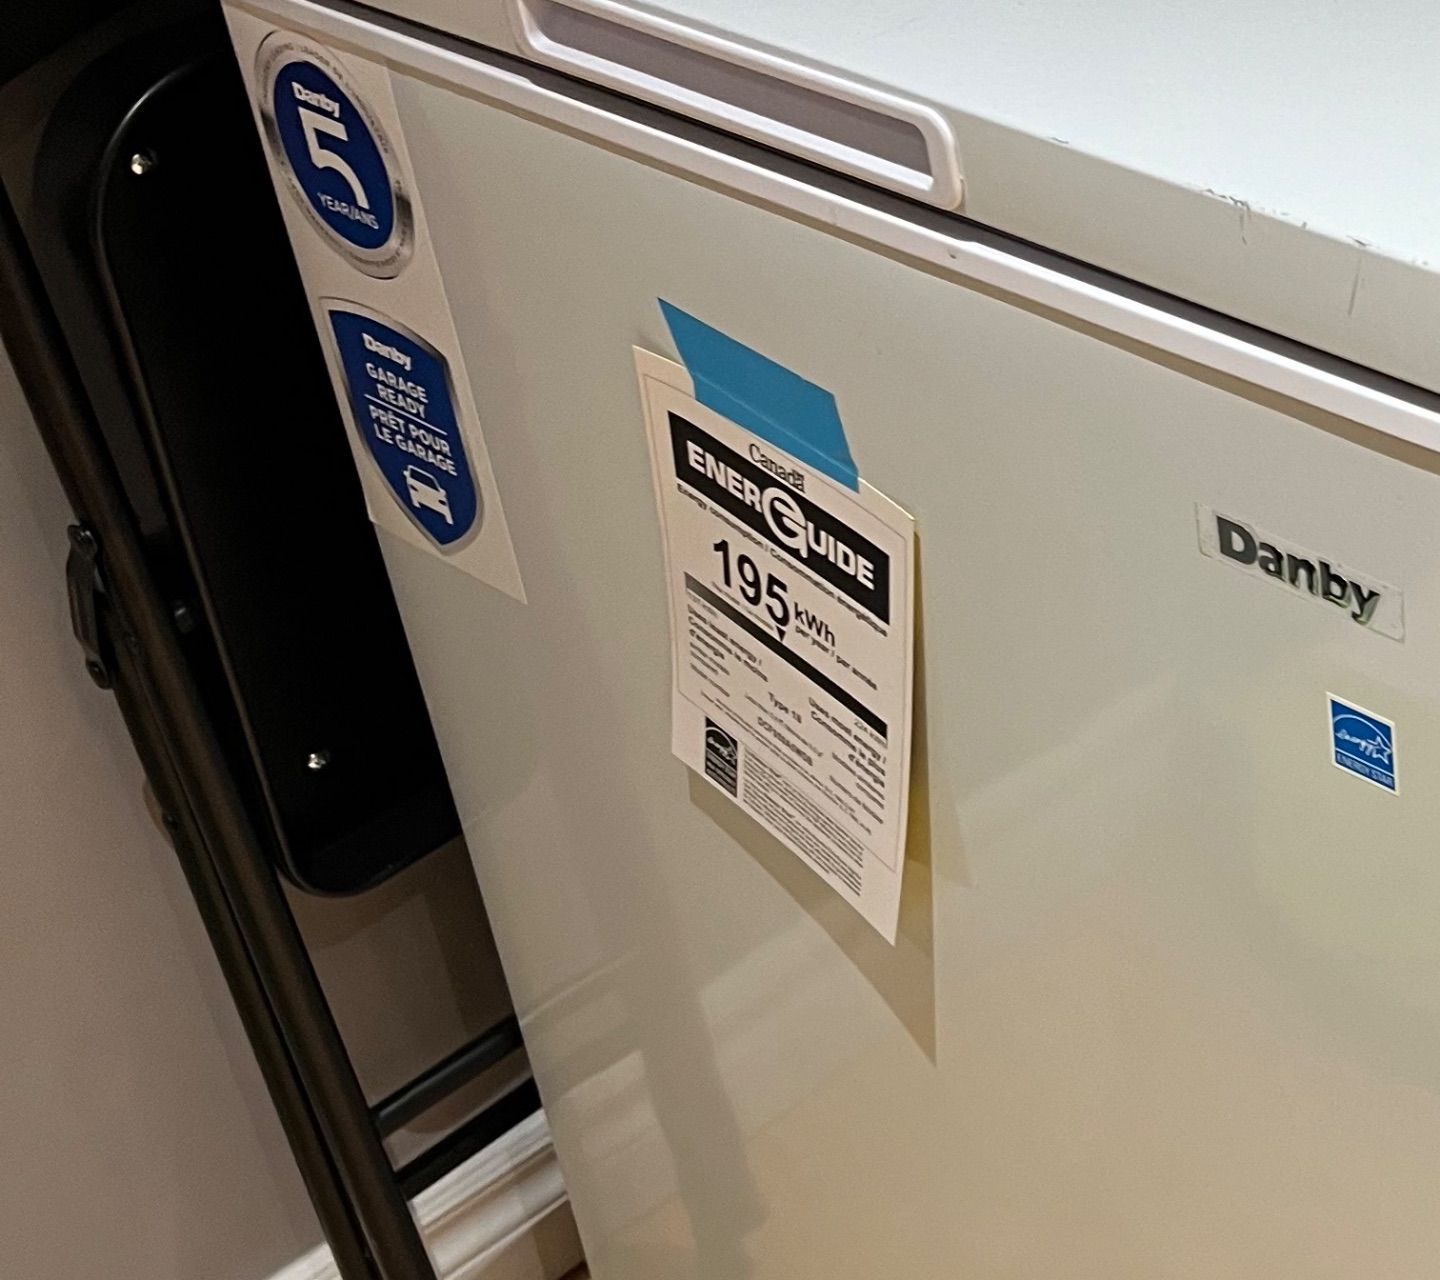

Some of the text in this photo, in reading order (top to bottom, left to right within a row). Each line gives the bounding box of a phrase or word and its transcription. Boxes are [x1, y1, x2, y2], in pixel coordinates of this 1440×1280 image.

[291, 81, 340, 118] Danby
[298, 106, 370, 211] 5
[361, 332, 413, 371] Danby
[366, 362, 428, 403] GARAGE
[377, 385, 426, 418] READY
[370, 405, 451, 457] PRÊT POUR
[373, 423, 457, 476] LE GARAGE
[748, 443, 806, 494] Canada
[712, 538, 791, 627] 195
[793, 602, 836, 648] kWh
[1216, 515, 1380, 625] Danby
